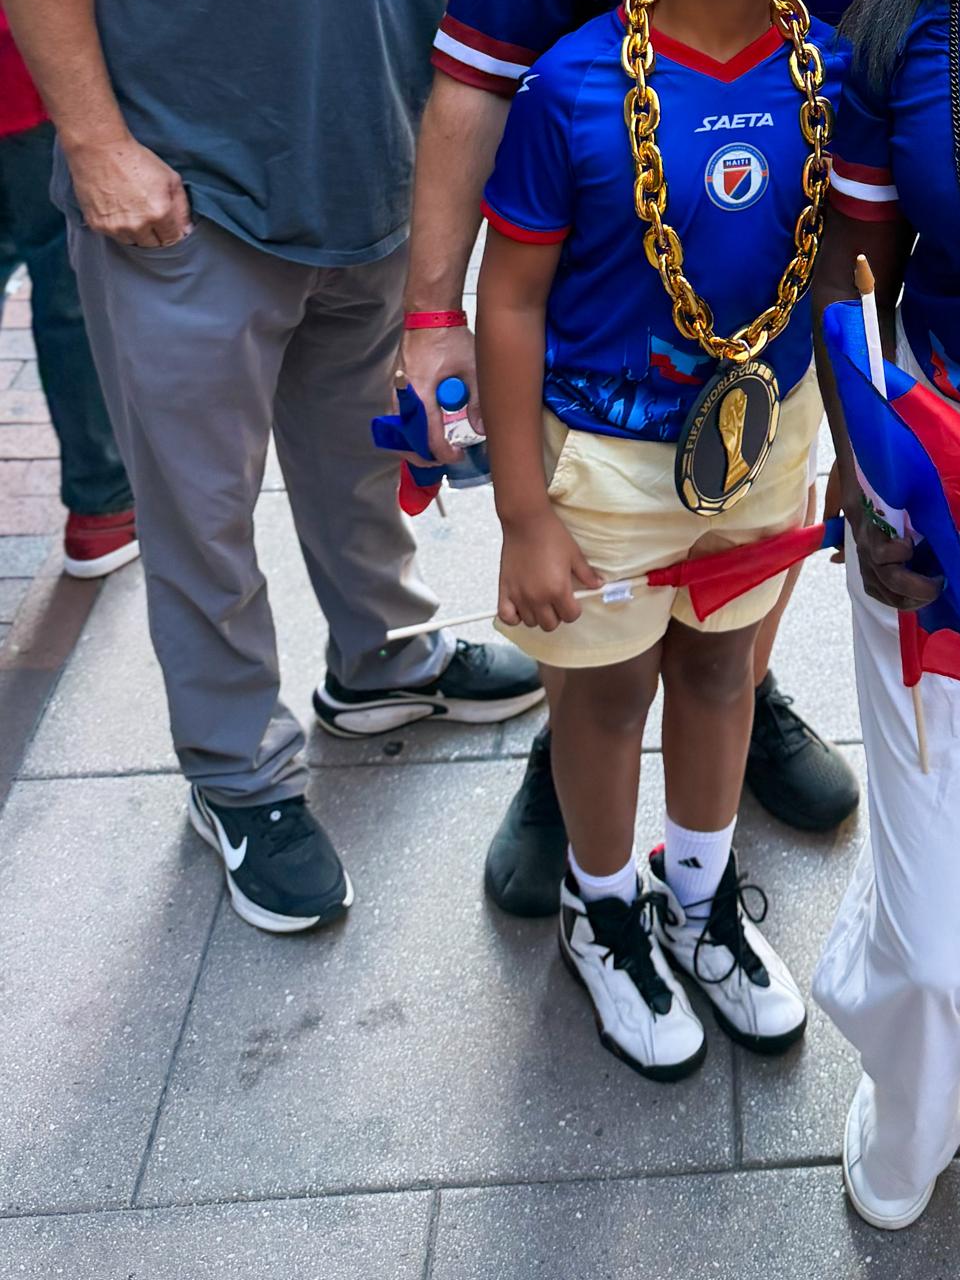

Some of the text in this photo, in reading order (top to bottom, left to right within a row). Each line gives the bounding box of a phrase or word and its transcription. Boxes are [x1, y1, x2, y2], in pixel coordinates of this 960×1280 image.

[694, 113, 774, 133] SAETA
[686, 417, 703, 450] FIFA
[700, 371, 737, 413] WORLD
[739, 362, 759, 376] CUP
